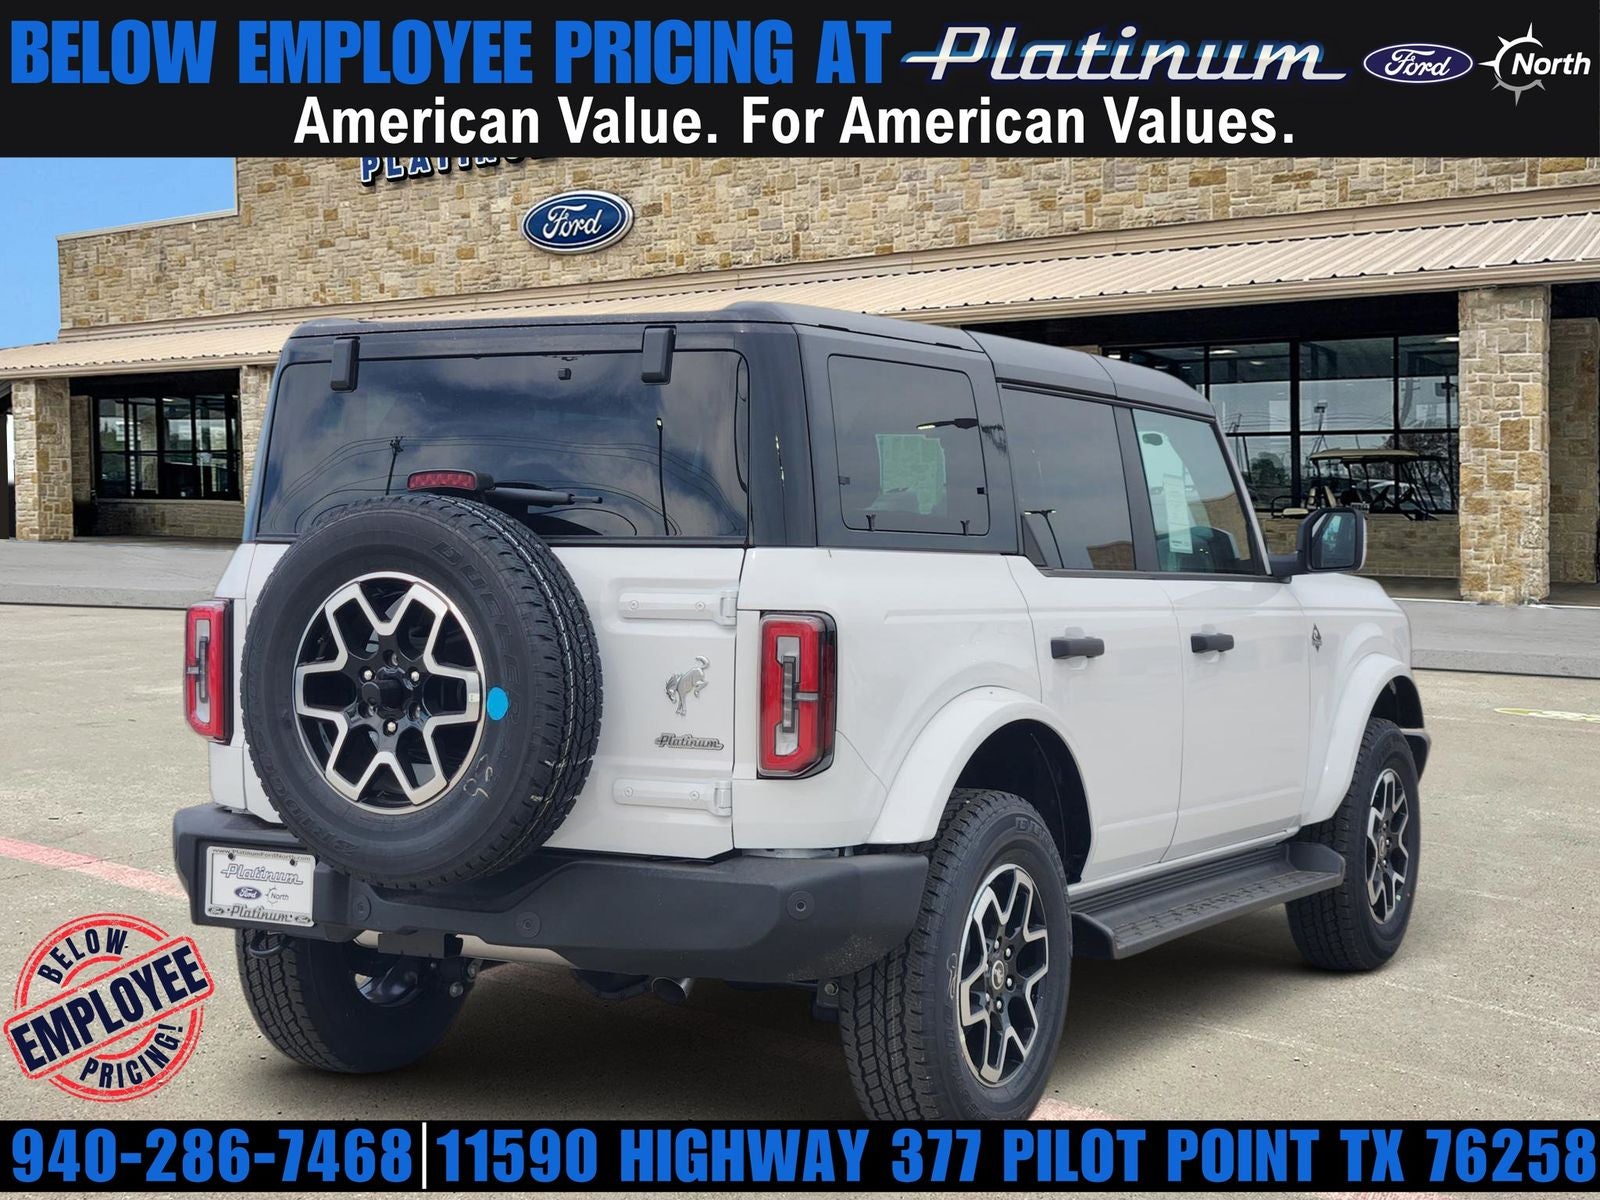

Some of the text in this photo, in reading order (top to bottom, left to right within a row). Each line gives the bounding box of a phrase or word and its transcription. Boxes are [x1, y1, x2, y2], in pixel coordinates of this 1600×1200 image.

[543, 203, 602, 239] Ford
[655, 733, 724, 750] Platinum
[220, 863, 303, 884] Platinum
[238, 888, 258, 898] Ford
[271, 893, 289, 901] North
[231, 904, 292, 921] Platinum
